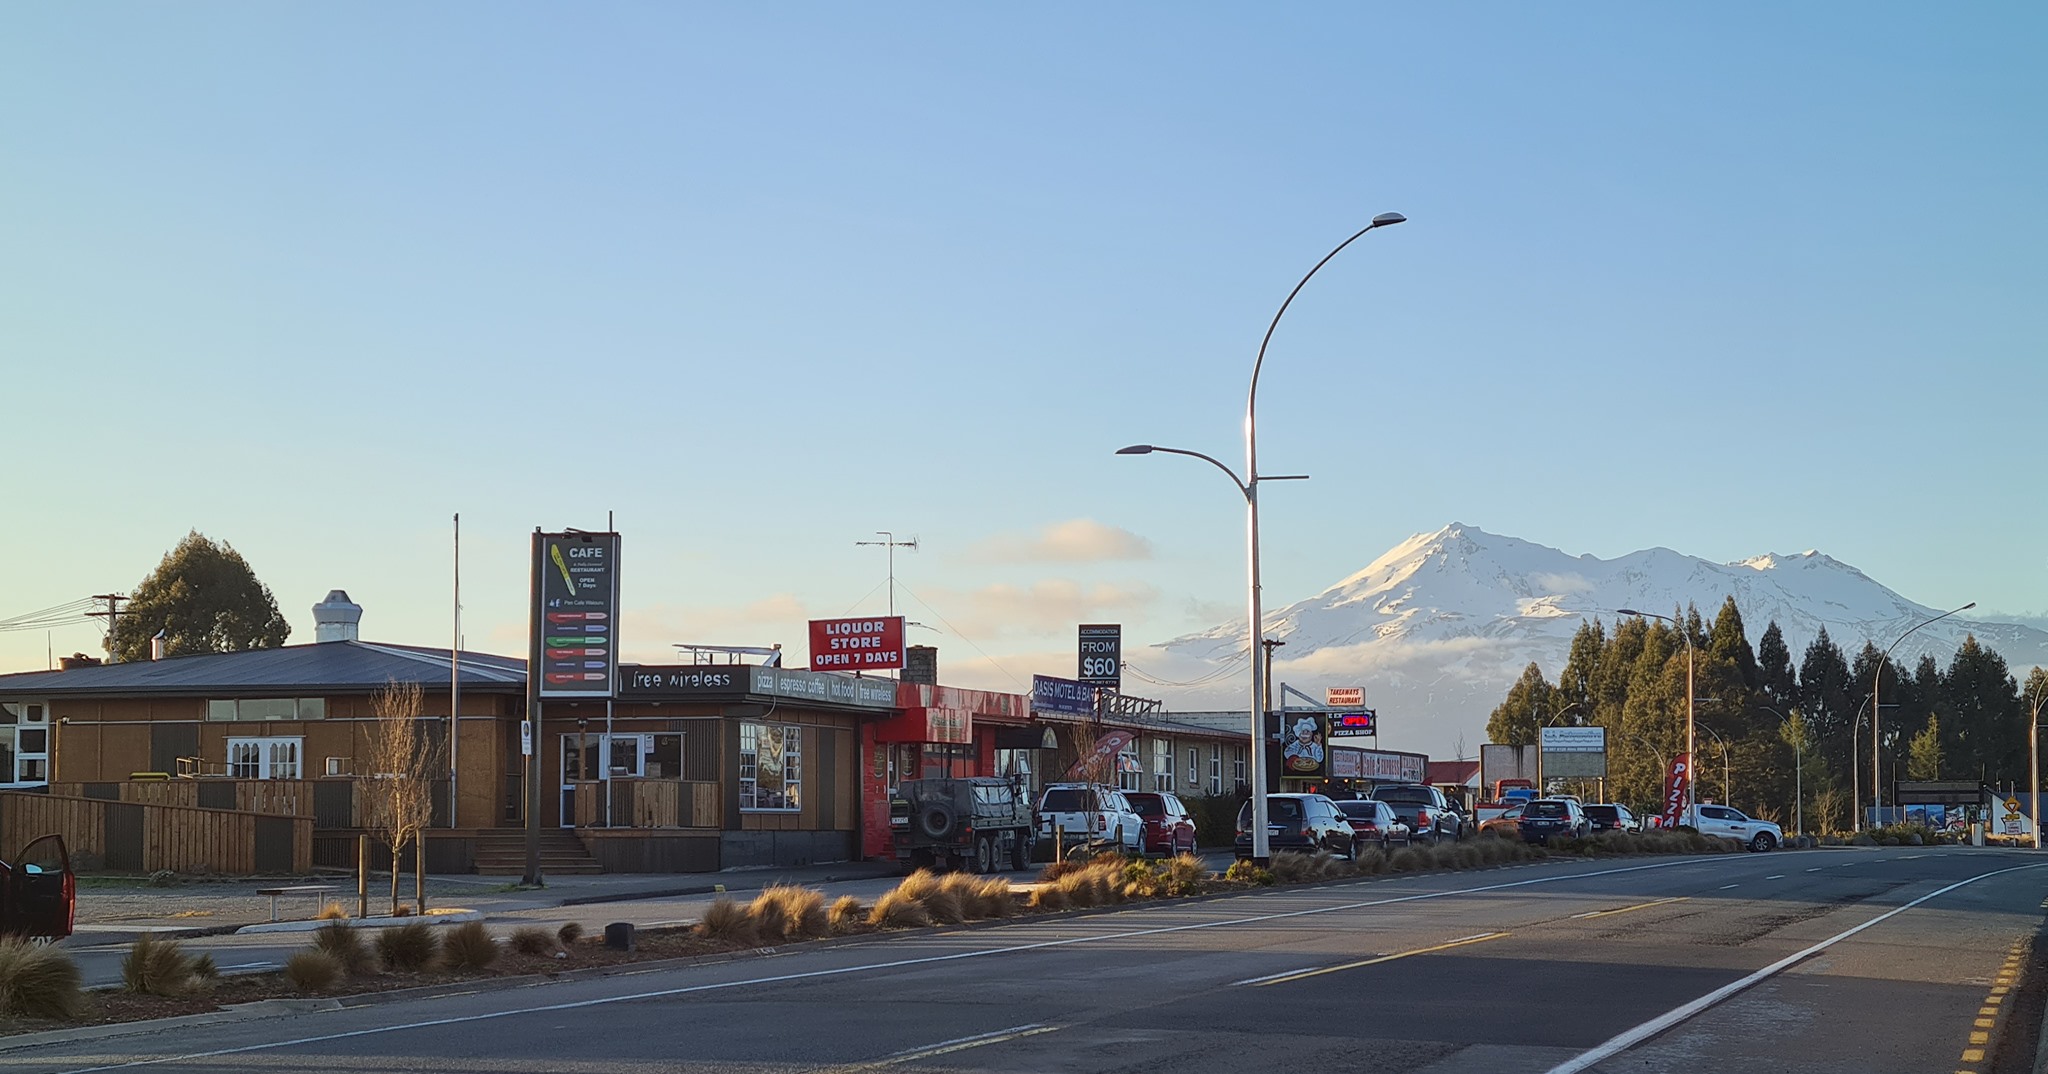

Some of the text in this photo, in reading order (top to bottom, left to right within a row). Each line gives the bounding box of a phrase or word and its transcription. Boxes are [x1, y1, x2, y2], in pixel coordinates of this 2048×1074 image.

[569, 548, 603, 558] CAFE
[826, 621, 884, 635] LIQUOR
[830, 636, 881, 649] STORE
[1081, 641, 1115, 653] FROM
[816, 651, 898, 665] OPEN 7 DAYS
[1083, 656, 1116, 678] $60
[632, 670, 730, 688] free wireless
[757, 671, 892, 702] pizza espresso coffee hot food free wireless
[1034, 680, 1095, 702] OASIS MOTEL & BAR
[1344, 716, 1368, 725] OPEN
[1663, 762, 1686, 828] PIZZA
